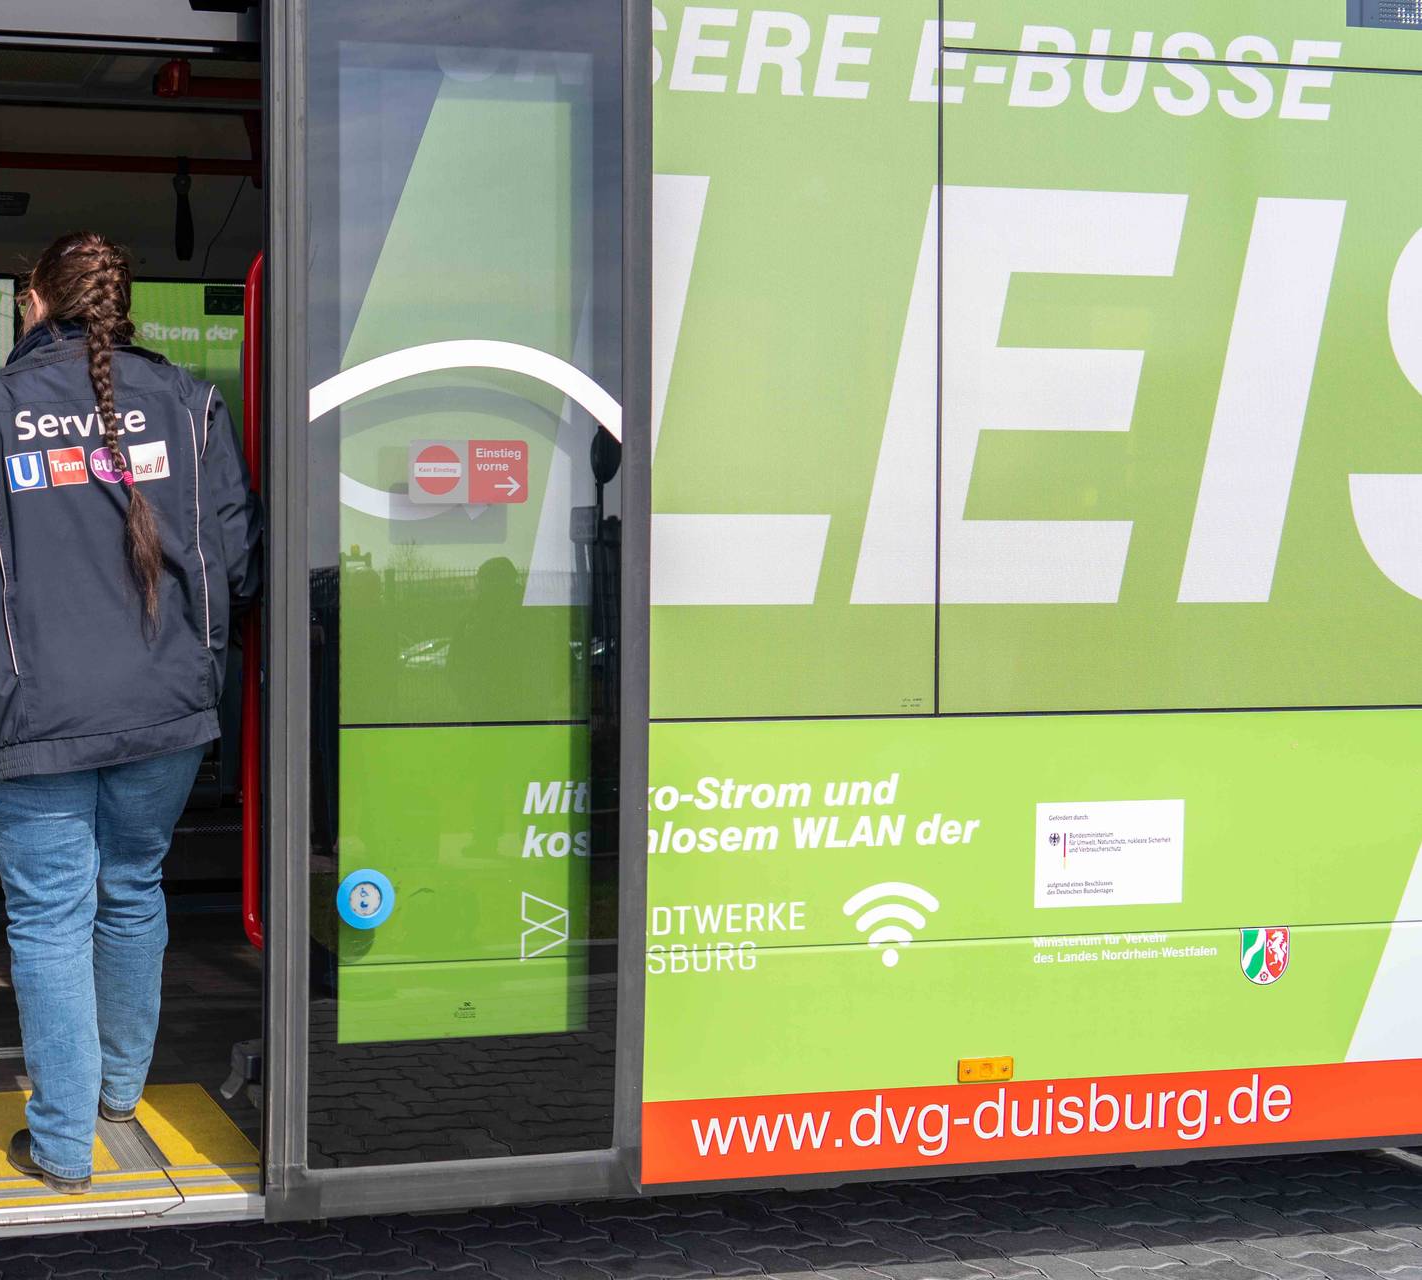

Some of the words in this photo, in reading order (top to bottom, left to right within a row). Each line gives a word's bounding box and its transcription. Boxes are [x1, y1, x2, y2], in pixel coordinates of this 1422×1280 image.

[909, 19, 1342, 121] E-BUSSE
[142, 322, 199, 341] Strom
[206, 324, 238, 341] der
[475, 448, 522, 460] Einstieg
[476, 463, 509, 472] vorne
[12, 455, 41, 487] U
[51, 460, 84, 473] Tram
[93, 458, 123, 473] BU
[824, 773, 900, 806] und
[793, 815, 906, 848] WLAN
[915, 814, 981, 846] der
[647, 902, 807, 936] DTWERKE
[1032, 935, 1102, 948] Ministerium
[1105, 934, 1121, 945] für
[1123, 933, 1168, 945] Verkehr
[1033, 952, 1054, 964] des
[1057, 951, 1099, 963] Landes
[1101, 946, 1218, 961] Nordrhein-Westfalen
[647, 941, 758, 975] SBURG
[690, 1074, 1293, 1157] www.dvg-duisburg.de
